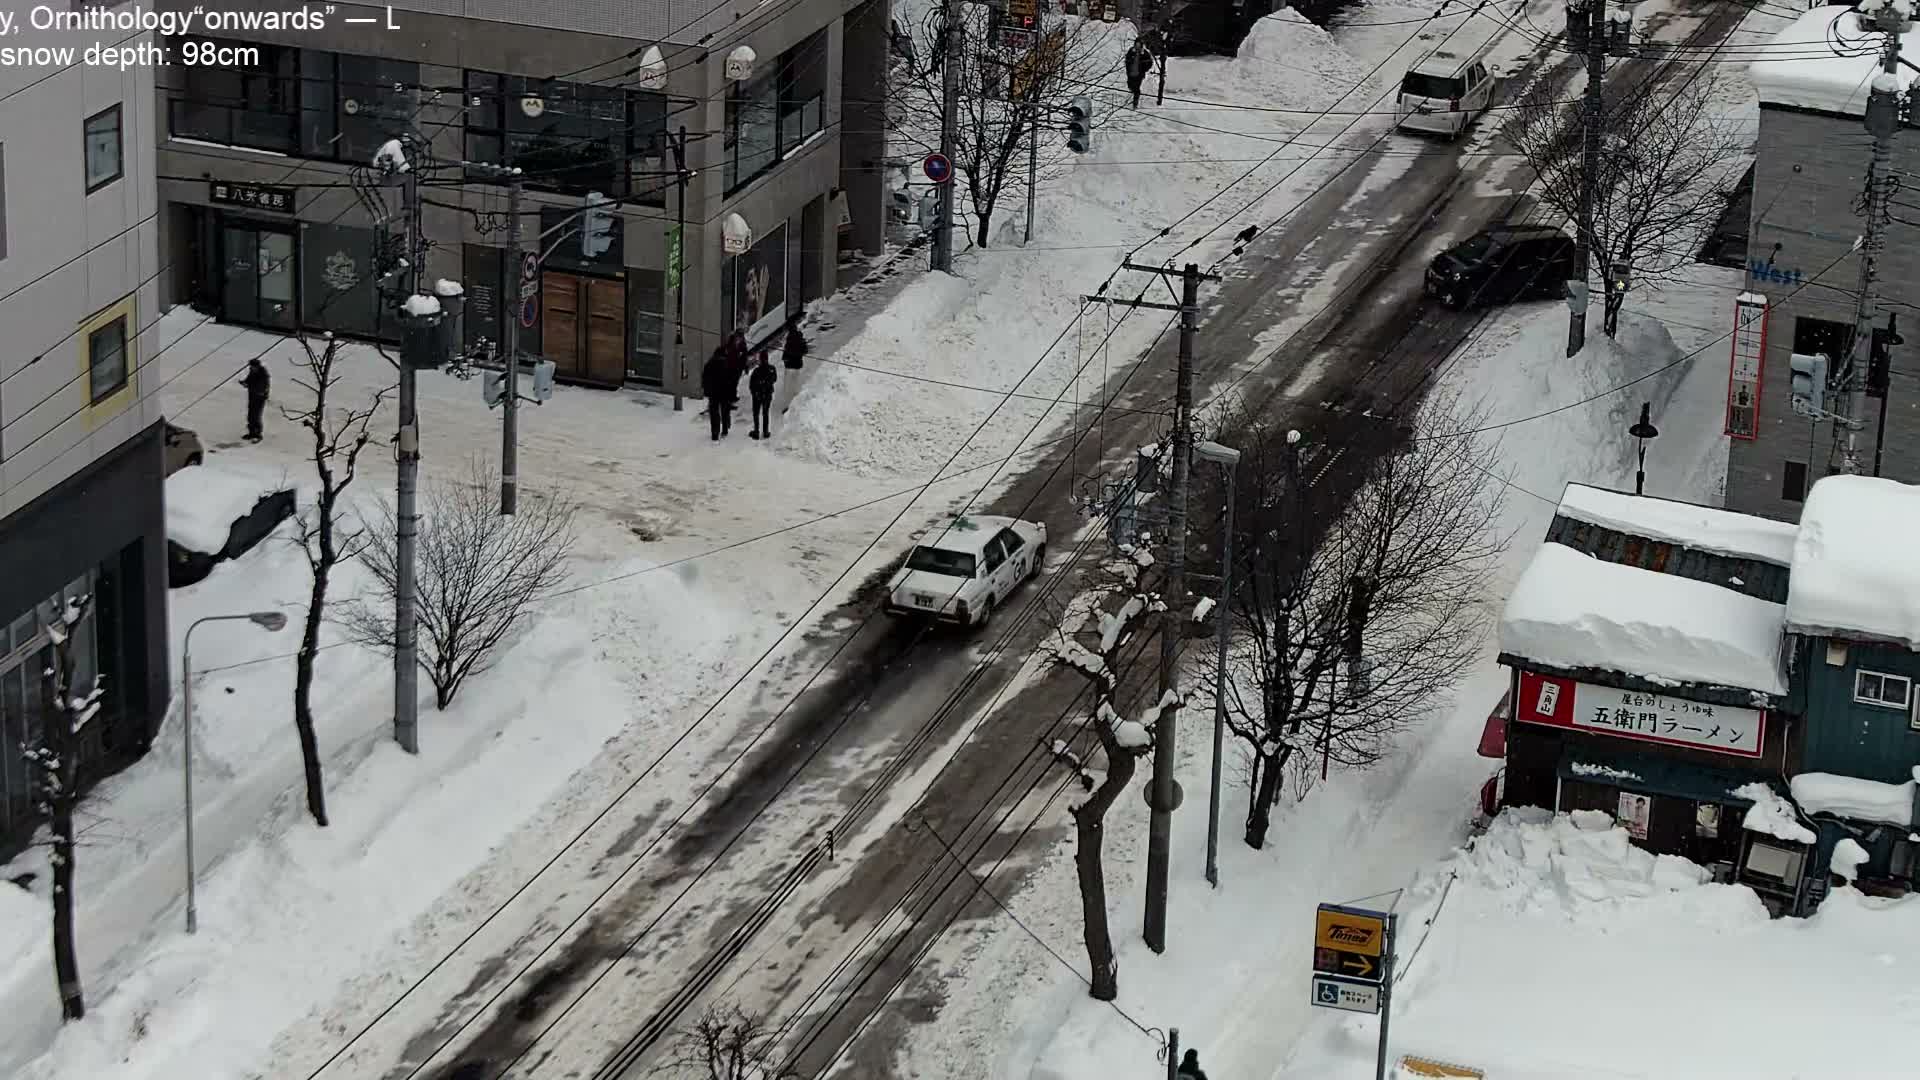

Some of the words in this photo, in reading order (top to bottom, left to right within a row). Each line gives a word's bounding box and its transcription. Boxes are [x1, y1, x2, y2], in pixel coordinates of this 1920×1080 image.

[1750, 261, 1802, 286] West
[1540, 685, 1557, 713] 三角山
[1621, 693, 1715, 718] 屋台のしょうゆ味
[1590, 706, 1746, 744] 五衛門ラーメン
[1328, 924, 1373, 944] Times
